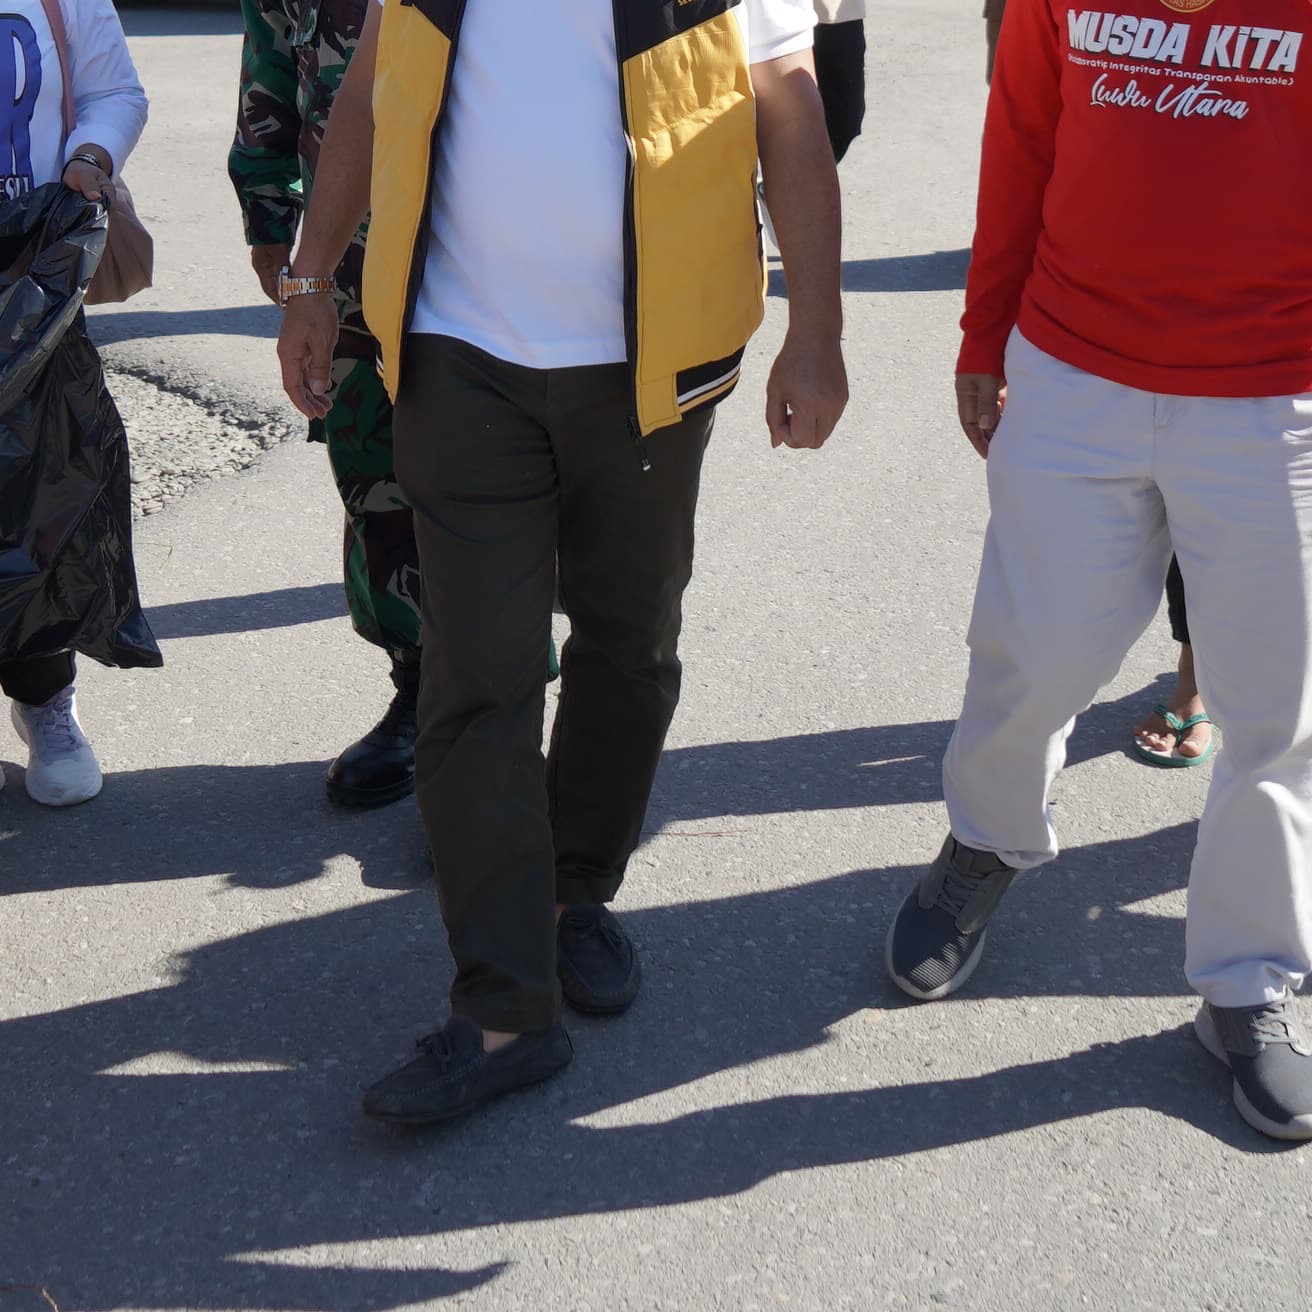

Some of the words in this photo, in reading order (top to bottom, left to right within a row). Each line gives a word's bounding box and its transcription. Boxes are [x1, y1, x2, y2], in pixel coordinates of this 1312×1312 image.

[1067, 9, 1191, 65] MUSDA
[1109, 62, 1161, 76] Integritas
[1164, 67, 1232, 83] Transparan
[1155, 80, 1250, 119] Utara
